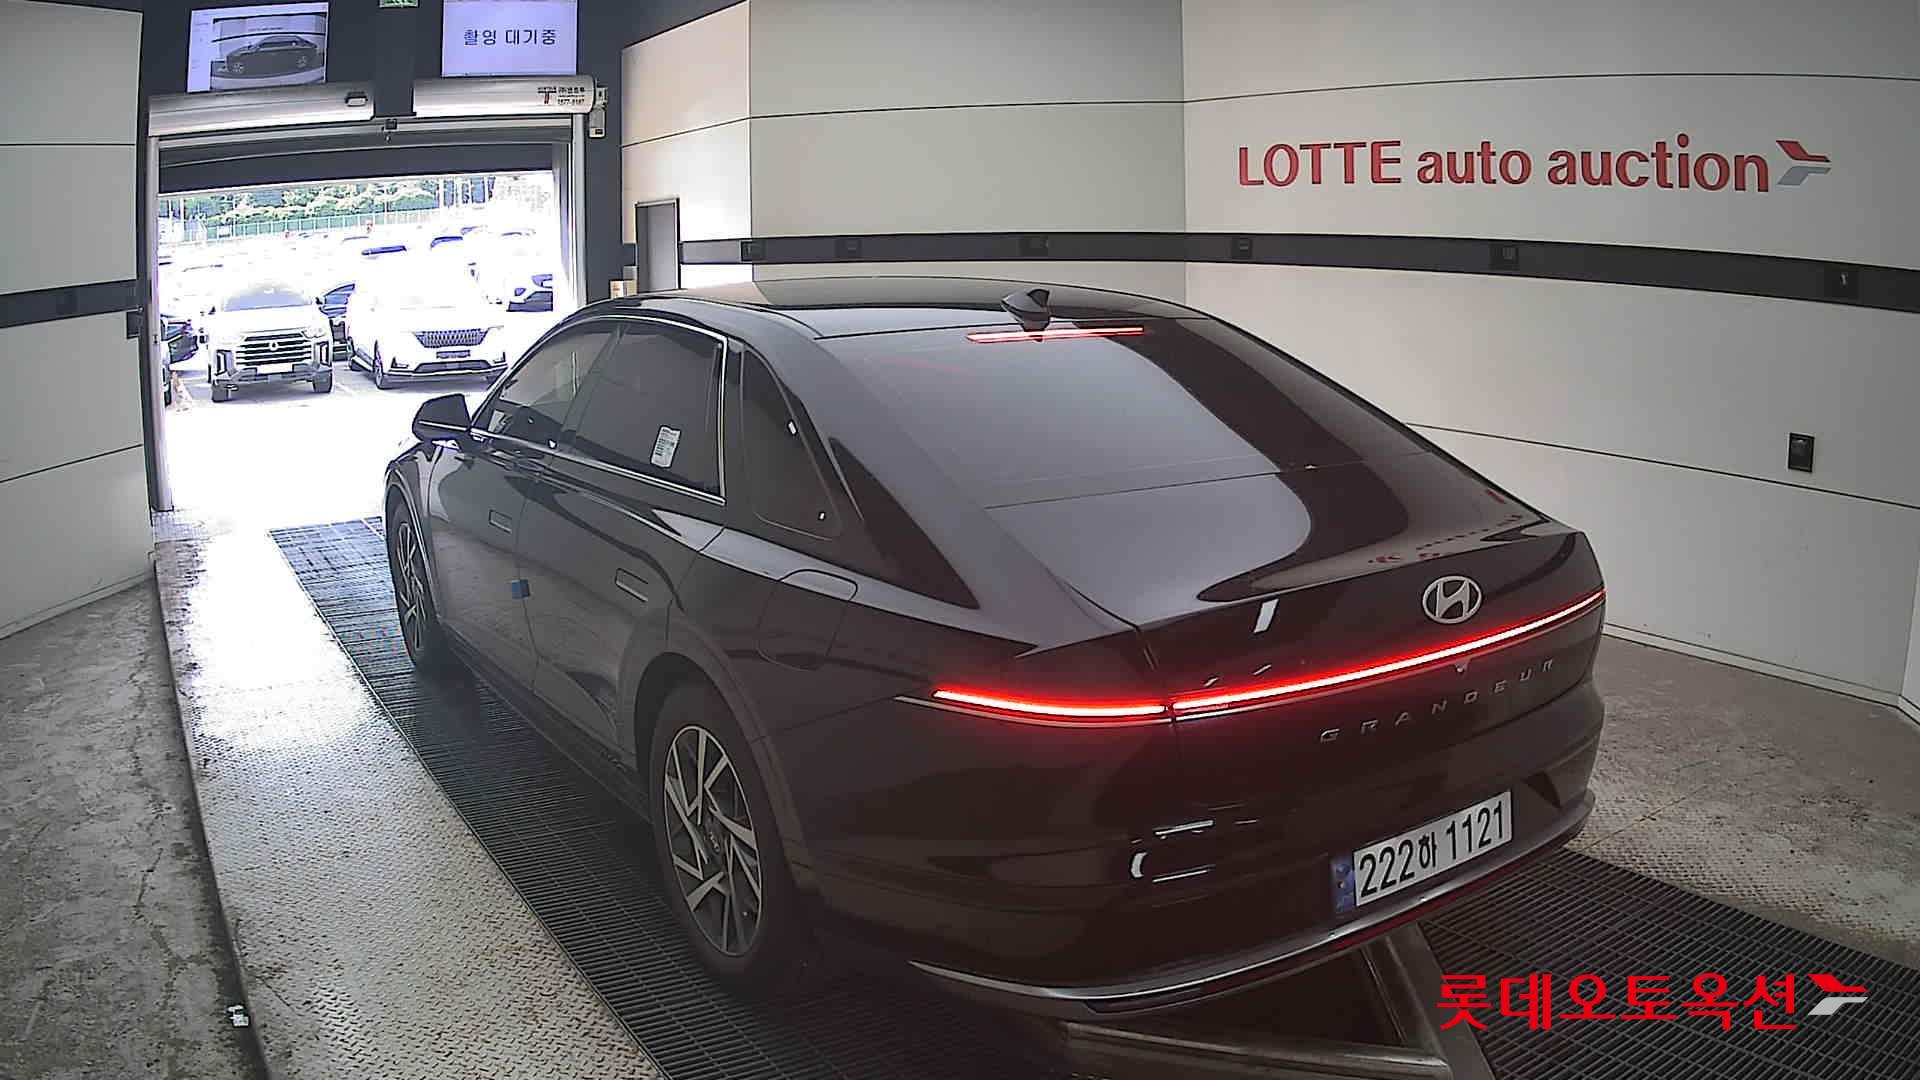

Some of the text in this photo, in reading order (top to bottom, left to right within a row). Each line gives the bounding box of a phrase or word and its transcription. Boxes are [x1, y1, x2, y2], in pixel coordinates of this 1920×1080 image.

[505, 29, 556, 46] 대기중
[1239, 133, 1769, 193] LOTTE auto auction
[1320, 658, 1554, 743] GRANDEUR
[1359, 800, 1504, 898] 222하 1121
